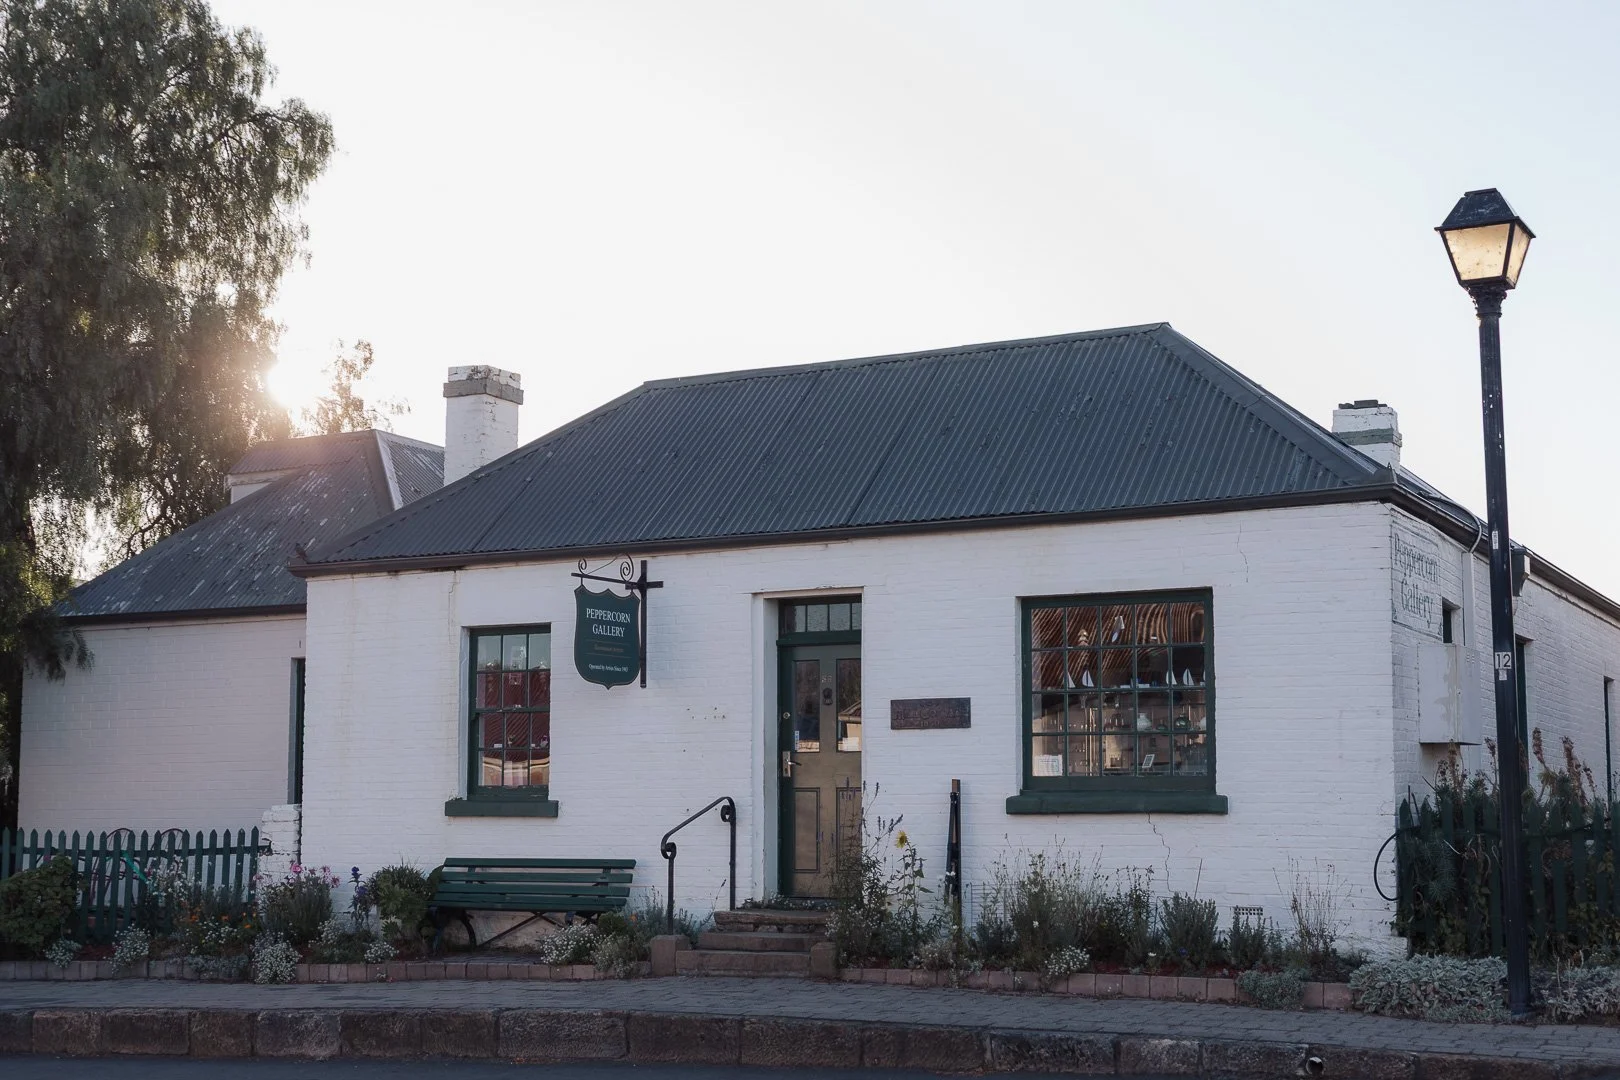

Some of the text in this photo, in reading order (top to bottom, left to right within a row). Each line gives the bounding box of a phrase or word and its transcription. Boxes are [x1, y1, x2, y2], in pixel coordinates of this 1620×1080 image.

[1394, 533, 1440, 582] Peppercorn
[1401, 579, 1433, 628] Gallery
[586, 607, 631, 623] PEPPERCORN
[592, 623, 625, 637] GALLERY
[1496, 653, 1511, 668] 12
